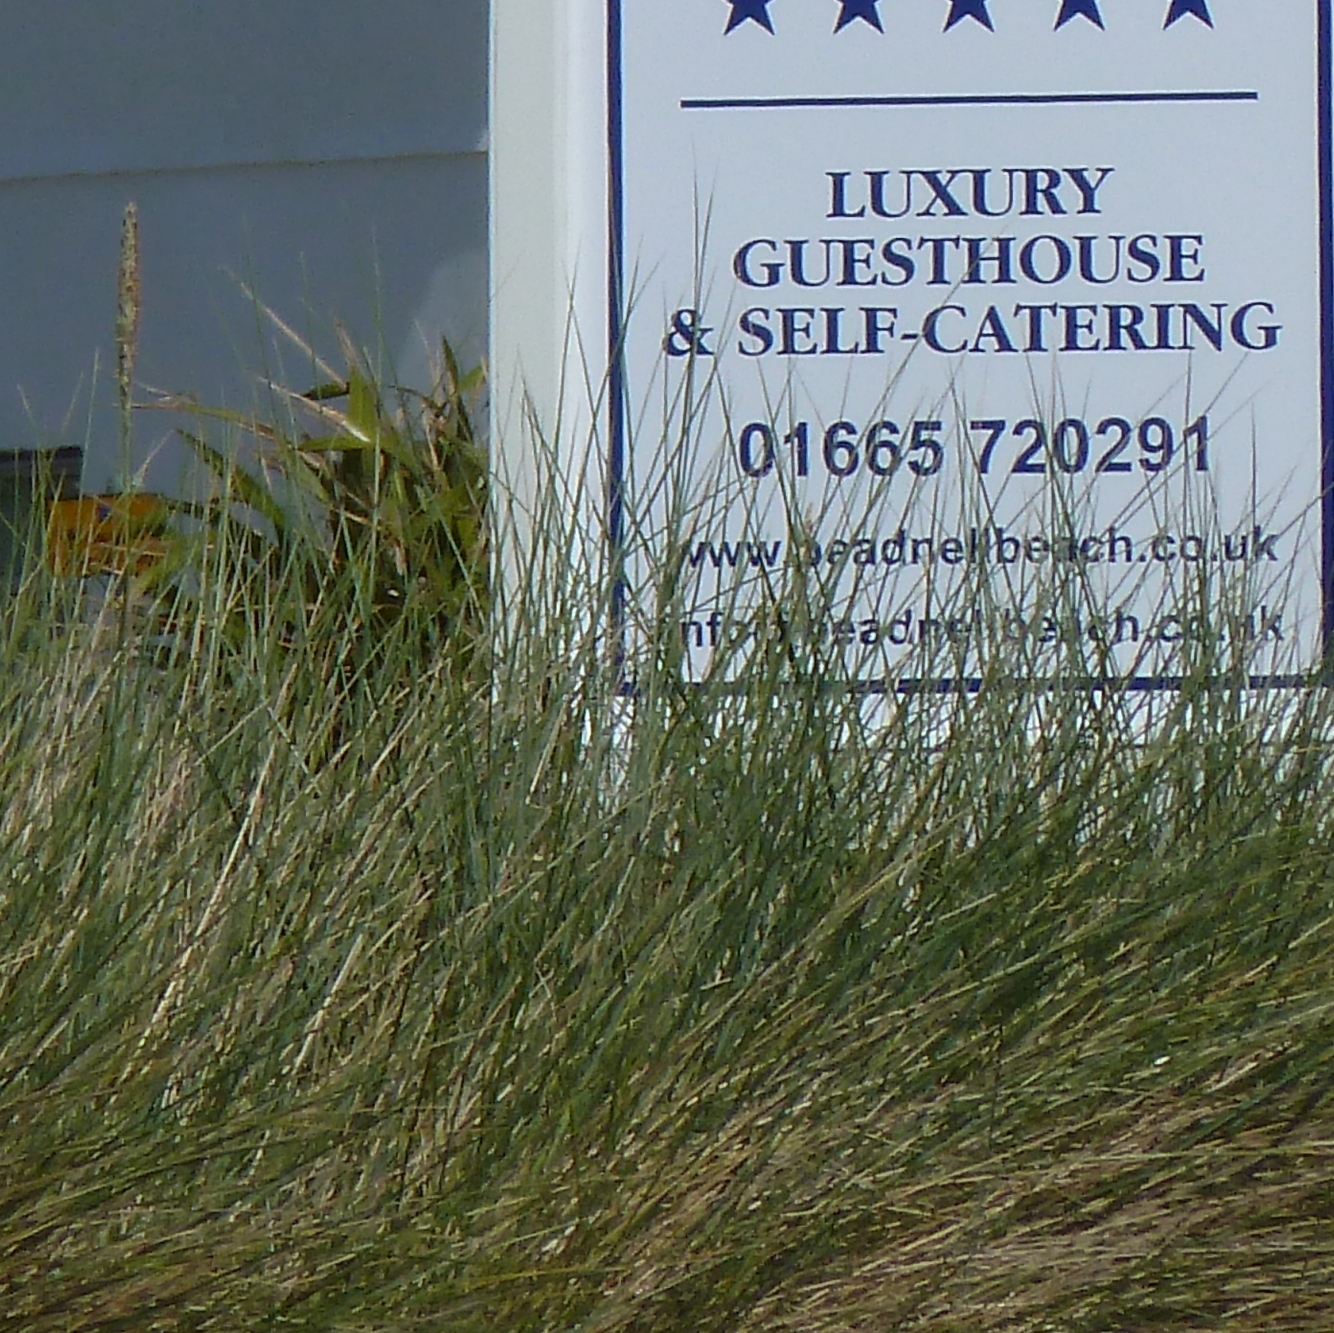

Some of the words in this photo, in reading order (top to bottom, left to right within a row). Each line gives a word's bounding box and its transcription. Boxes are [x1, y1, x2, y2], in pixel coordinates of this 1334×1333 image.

[826, 167, 1115, 218] LUXURY
[733, 234, 1206, 288] GUESTHOUSE
[663, 308, 715, 357] &
[737, 301, 1283, 357] SELF-CATERING
[738, 419, 944, 478] 01665
[970, 414, 1210, 474] 720291
[683, 525, 1279, 569] wwweadnellbech.co.uk
